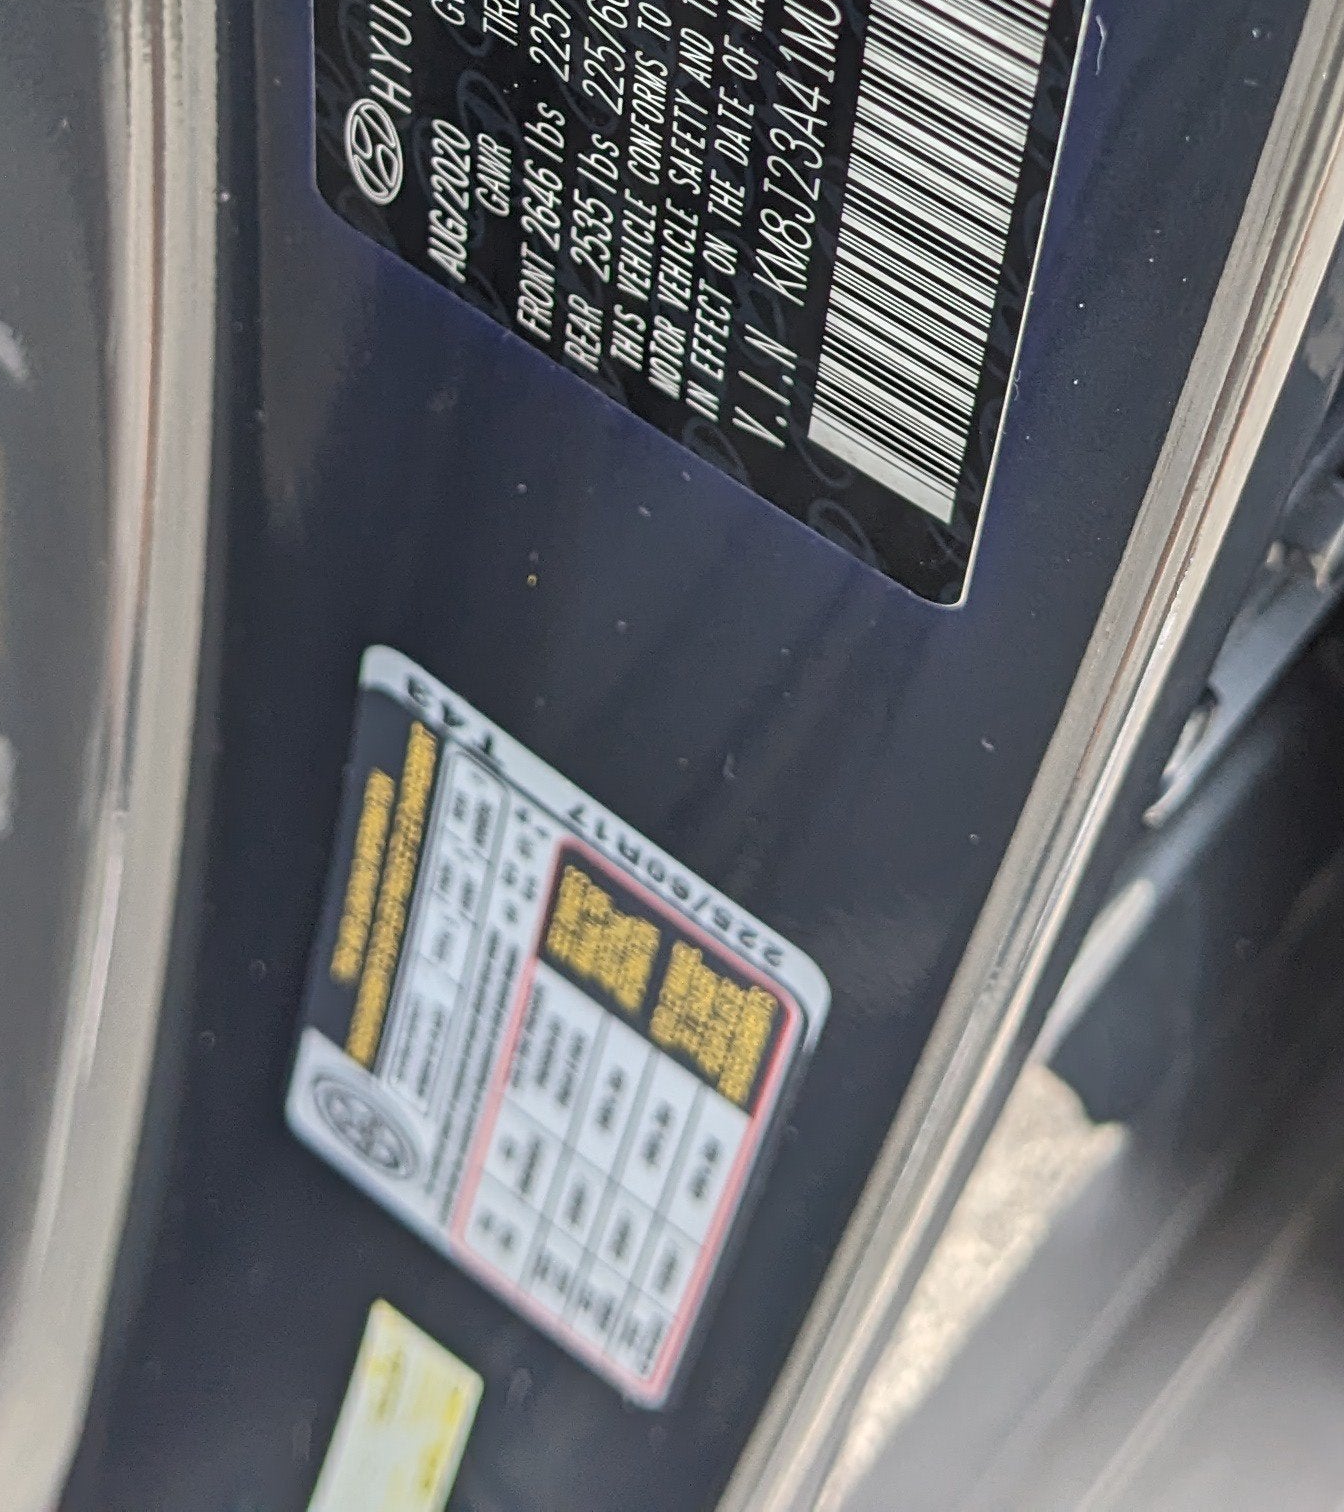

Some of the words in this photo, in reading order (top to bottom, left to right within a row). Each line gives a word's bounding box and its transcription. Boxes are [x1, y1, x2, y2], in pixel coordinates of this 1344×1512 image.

[636, 0, 672, 42] TO
[677, 26, 715, 89] AND
[721, 33, 759, 81] OF
[626, 49, 668, 185] CONFORMS
[667, 87, 709, 195] SAFETY
[712, 84, 755, 167] DATE
[427, 117, 471, 282] AUG/2020
[473, 132, 512, 216] GAWR
[706, 167, 746, 227] THE
[615, 187, 657, 301] VEHICLE
[655, 196, 699, 311] VEHICLE
[701, 231, 738, 275] ON
[516, 240, 555, 340] FRONT
[689, 276, 732, 382] EFFECT
[563, 292, 603, 372] REAR
[608, 302, 647, 370] THIS
[647, 313, 686, 398] MOTOR
[684, 379, 720, 421] IN
